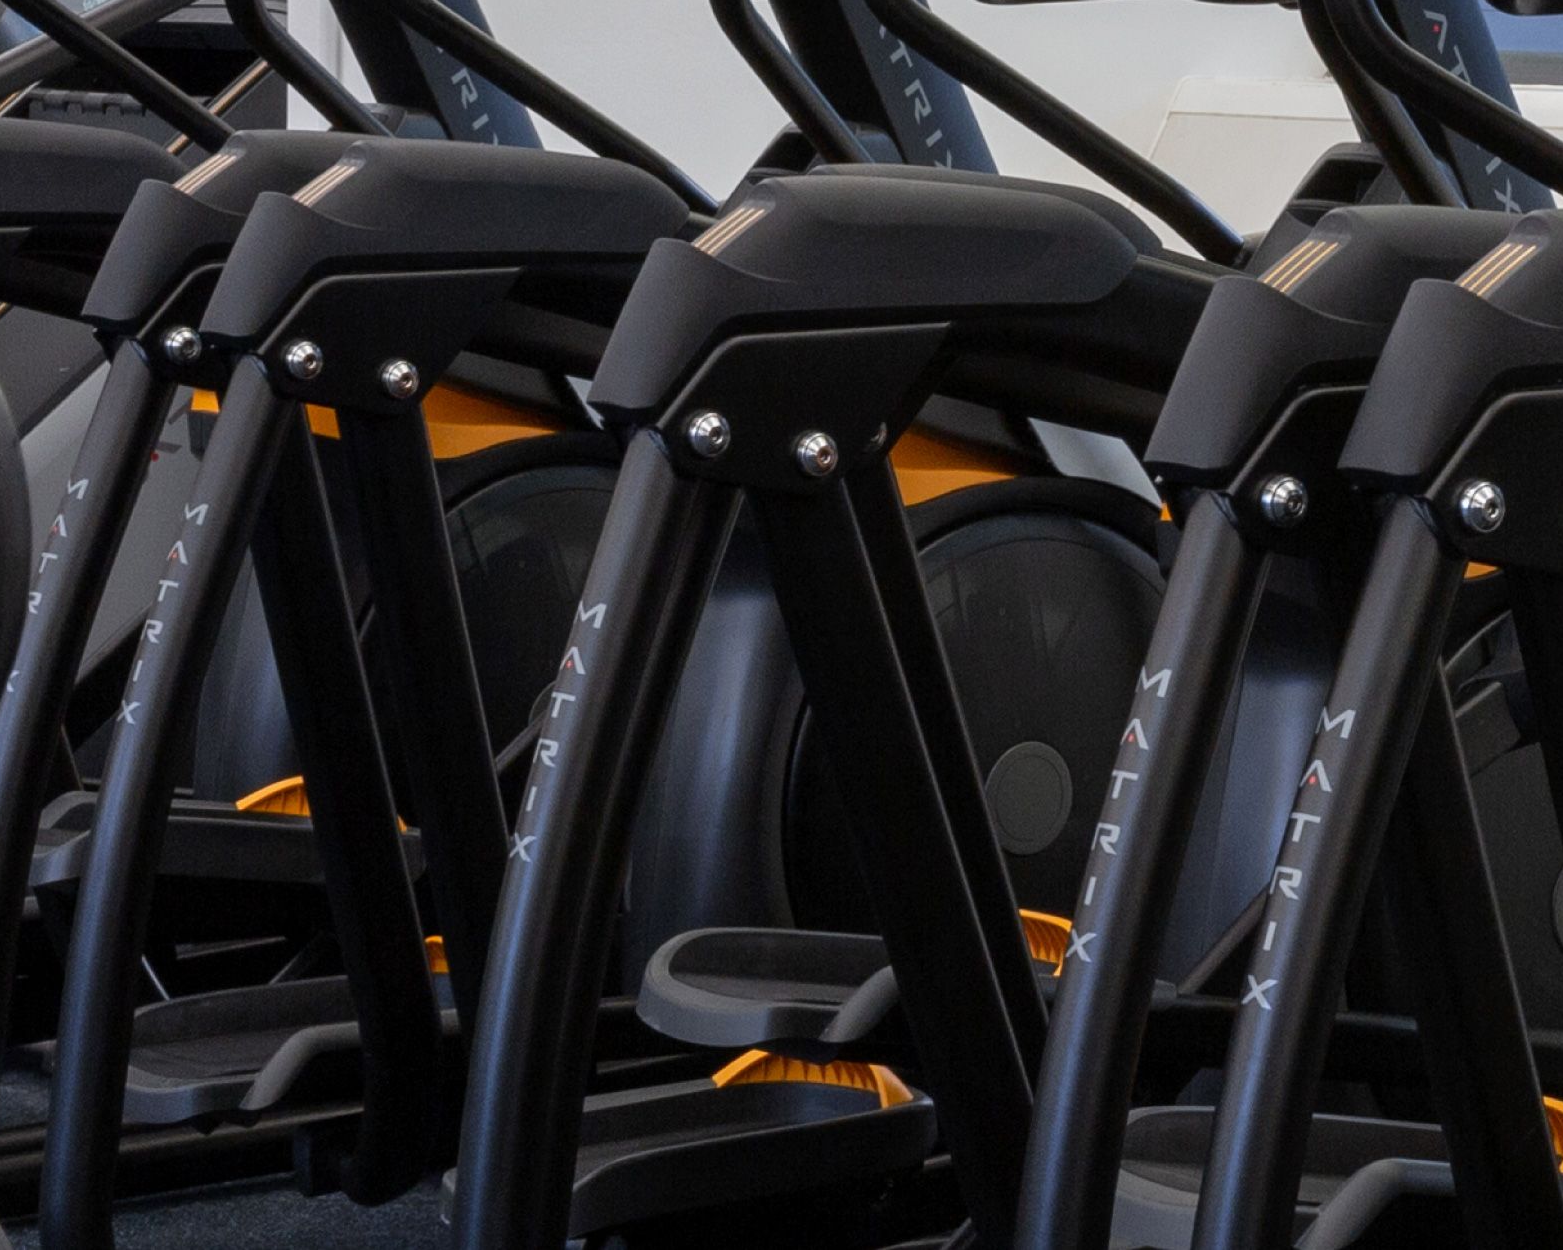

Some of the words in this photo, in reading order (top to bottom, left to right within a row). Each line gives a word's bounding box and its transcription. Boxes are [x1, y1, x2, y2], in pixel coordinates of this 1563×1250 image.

[7, 478, 89, 692] MATR
[117, 502, 209, 725] MATRIX
[509, 600, 607, 863] MATRIX
[1066, 666, 1172, 963] MATRIX
[1241, 707, 1357, 1011] MATRIX
